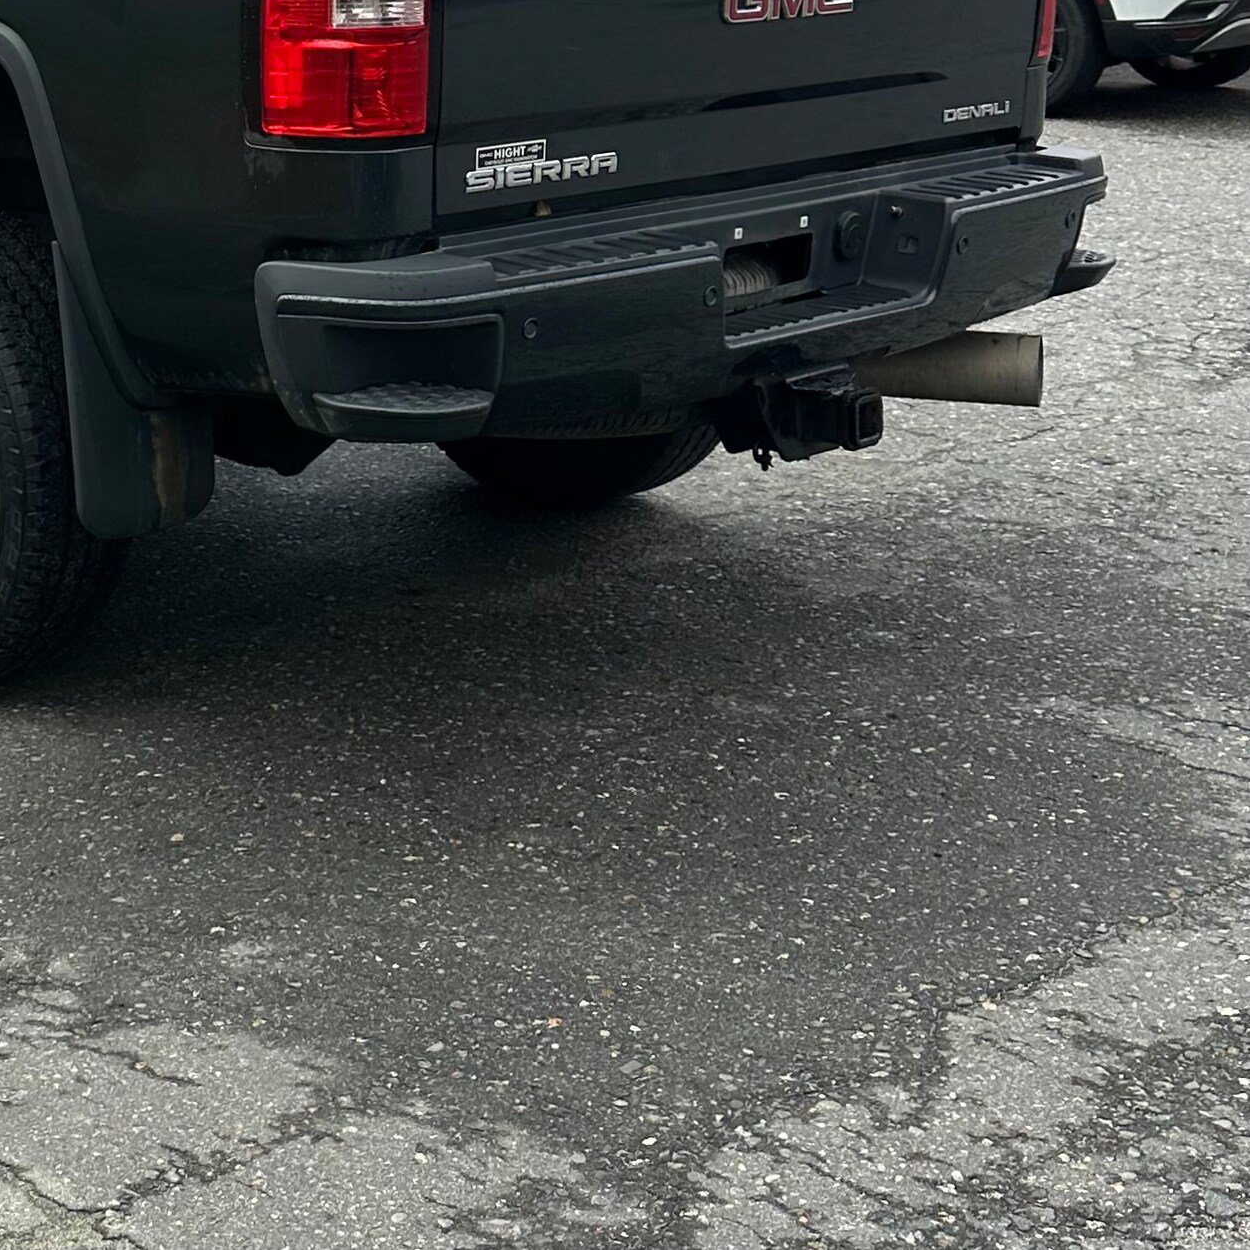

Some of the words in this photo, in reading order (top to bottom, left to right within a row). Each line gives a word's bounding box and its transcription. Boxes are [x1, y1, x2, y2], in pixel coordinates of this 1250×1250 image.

[943, 100, 1010, 123] DENALI
[493, 145, 526, 160] HIGHT
[466, 151, 618, 194] SIERRA
